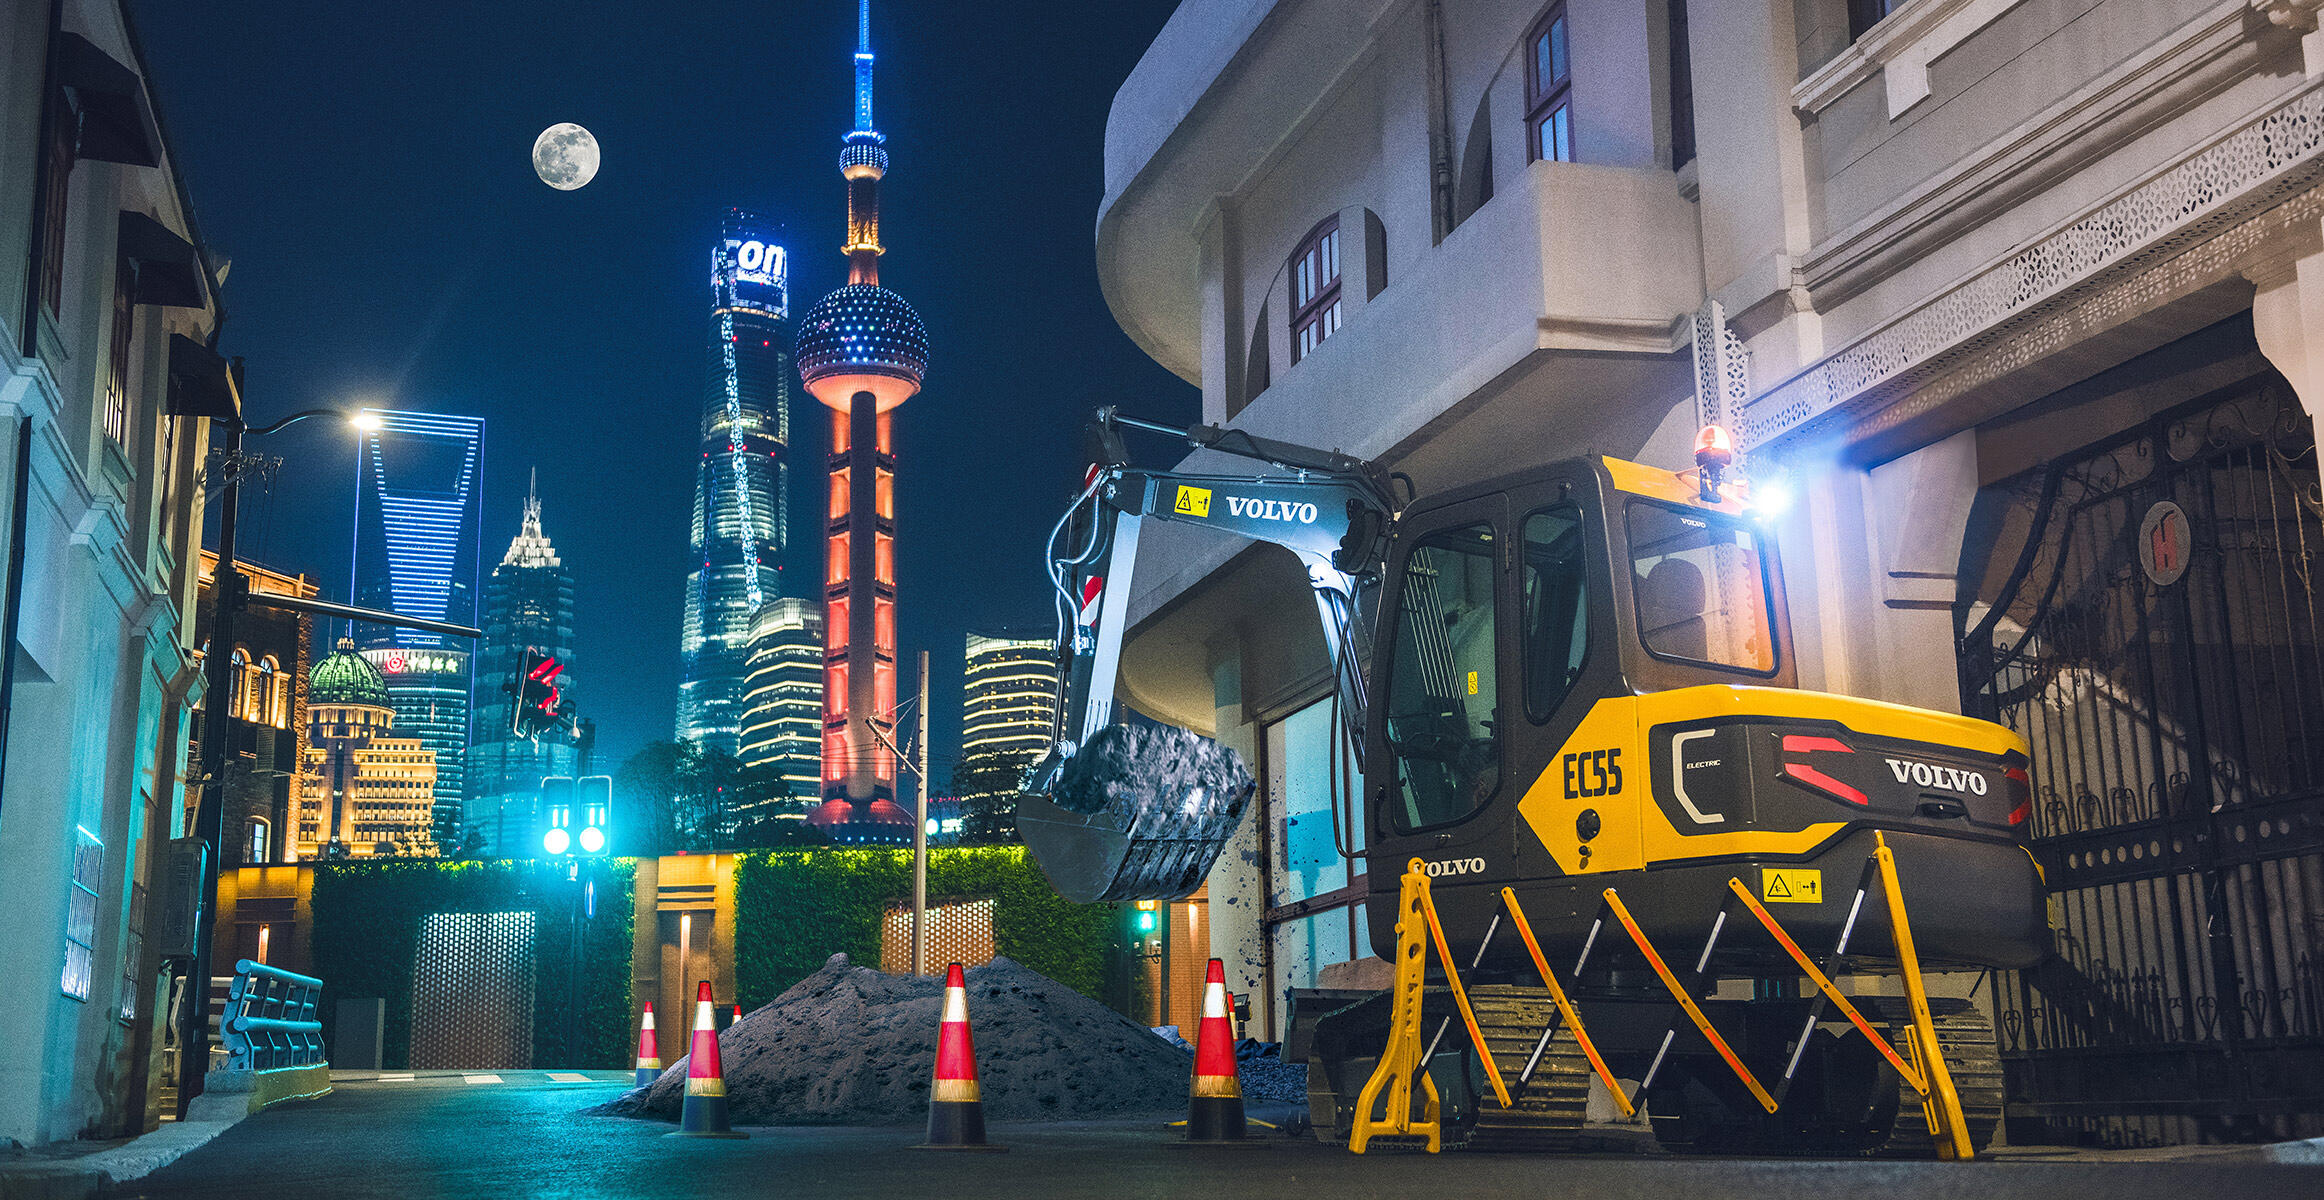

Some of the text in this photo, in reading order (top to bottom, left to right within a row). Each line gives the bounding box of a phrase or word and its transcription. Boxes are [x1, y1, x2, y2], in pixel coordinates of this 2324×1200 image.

[1226, 496, 1318, 524] VOLVO
[1680, 517, 1707, 529] VOLVO
[1563, 748, 1622, 799] EC55
[1686, 759, 1721, 770] ELECTRIC
[1885, 758, 1988, 796] VOLVO
